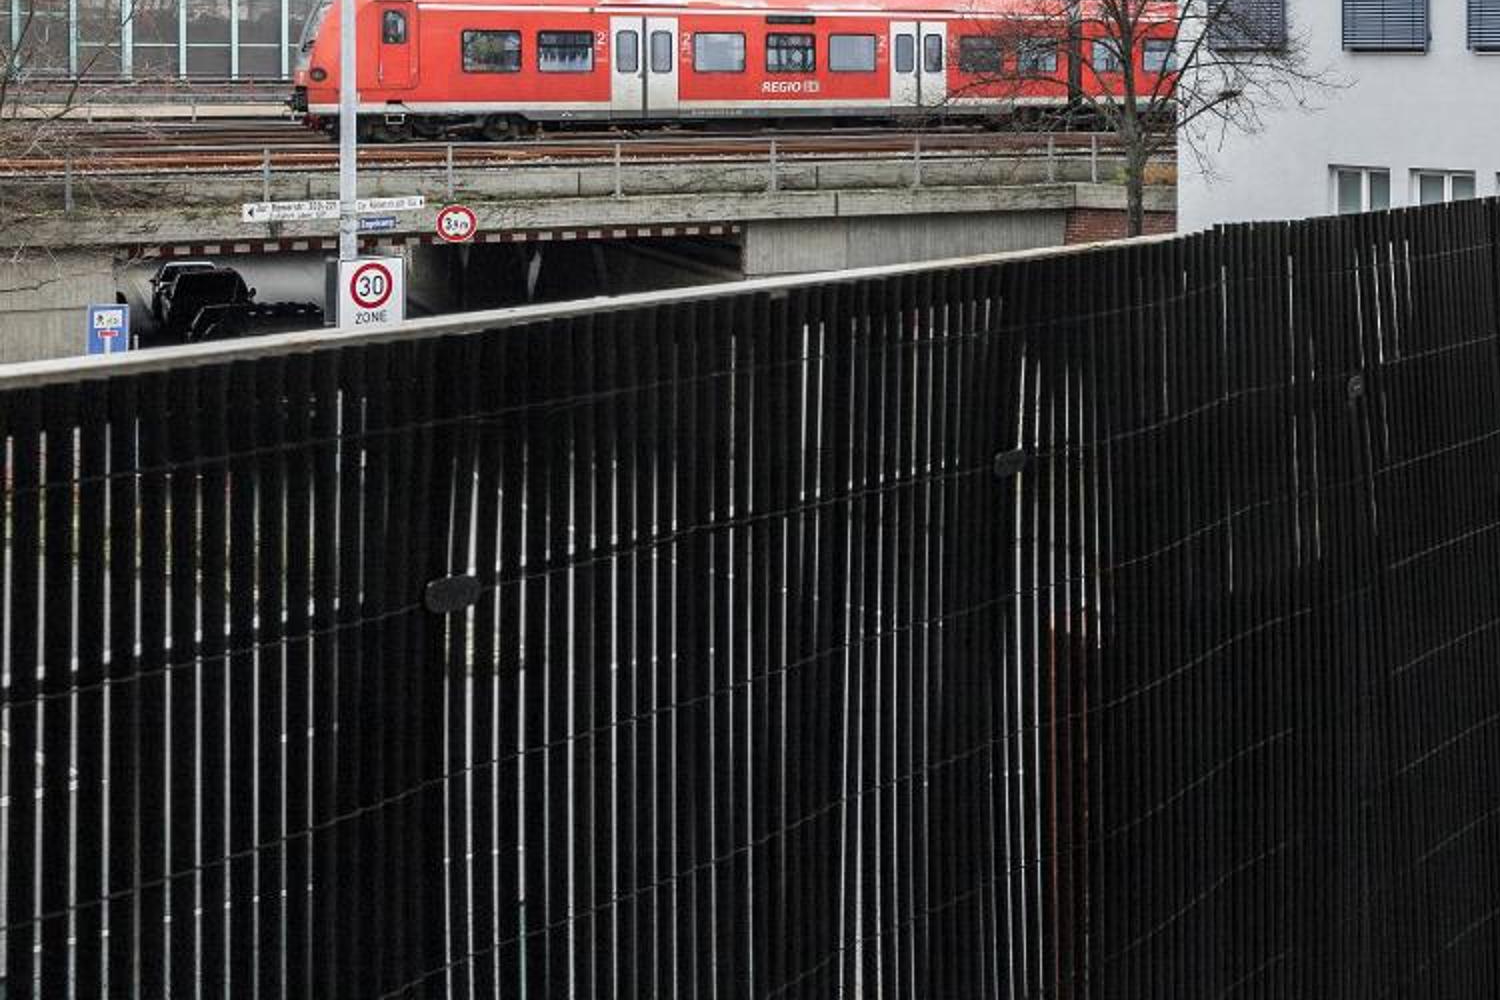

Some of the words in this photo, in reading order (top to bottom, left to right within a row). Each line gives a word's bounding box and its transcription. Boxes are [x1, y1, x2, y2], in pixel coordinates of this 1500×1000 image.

[761, 81, 801, 93] REGIO
[359, 275, 384, 297] 30
[355, 310, 388, 325] ZONE
